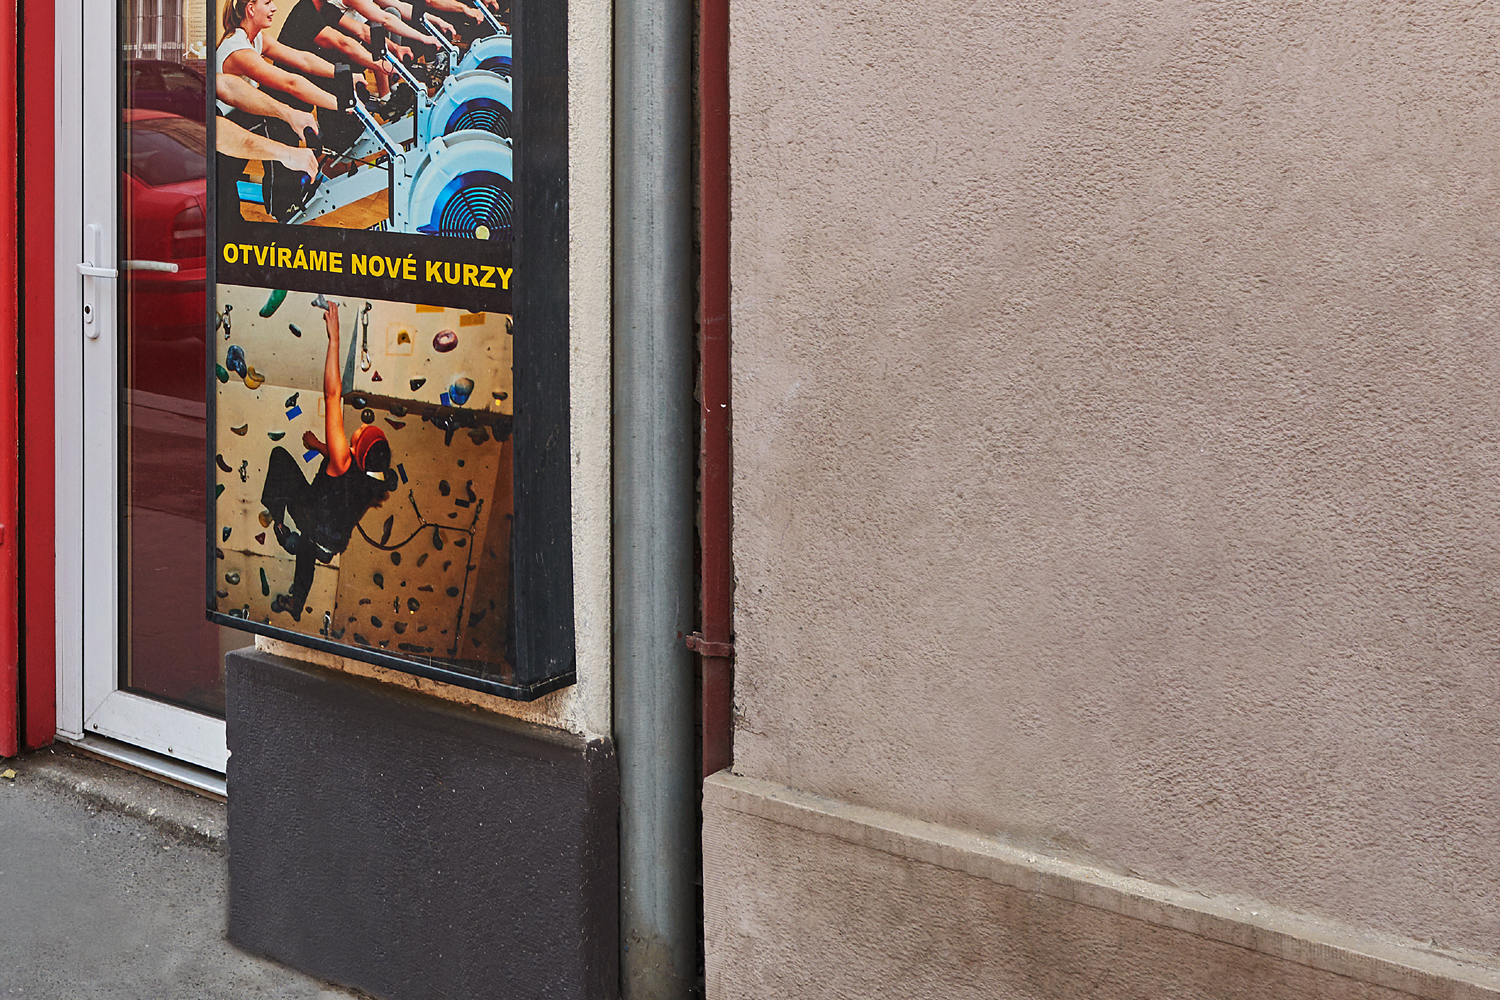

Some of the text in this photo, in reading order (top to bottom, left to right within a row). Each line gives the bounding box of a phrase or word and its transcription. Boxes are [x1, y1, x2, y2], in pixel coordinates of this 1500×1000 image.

[223, 242, 513, 290] OTVÍRÁME NOVÉ KURZY
